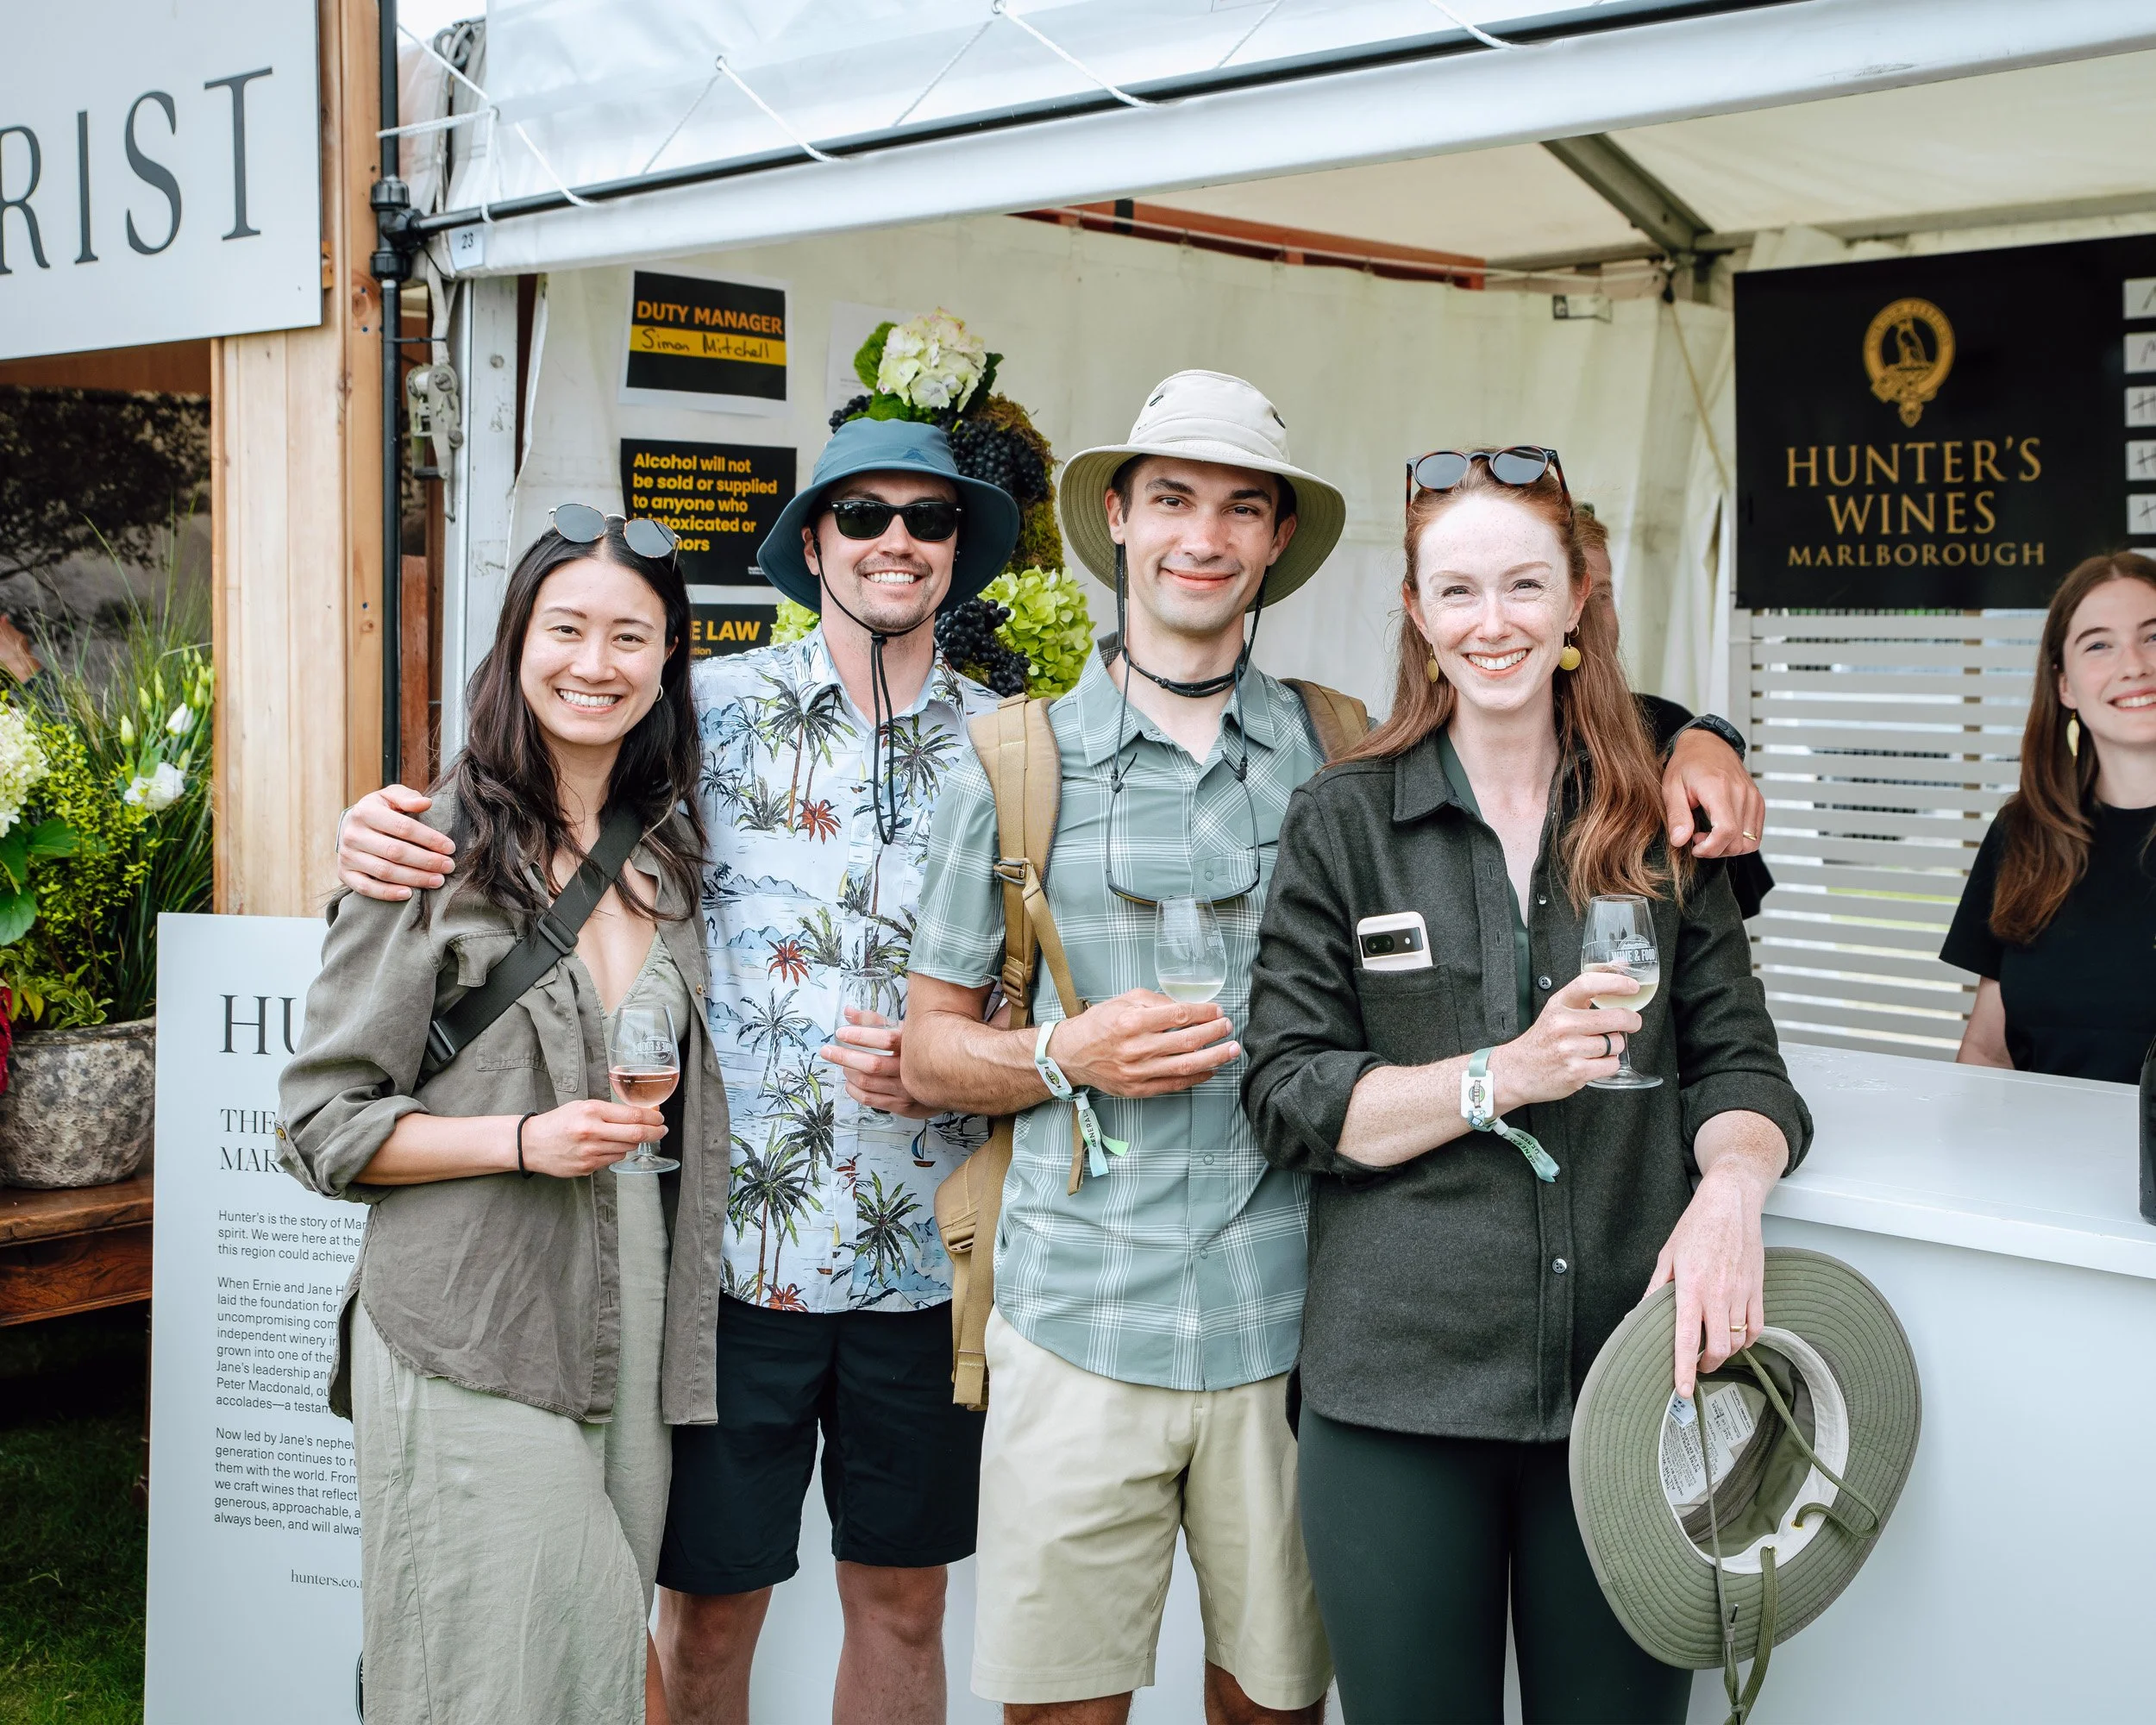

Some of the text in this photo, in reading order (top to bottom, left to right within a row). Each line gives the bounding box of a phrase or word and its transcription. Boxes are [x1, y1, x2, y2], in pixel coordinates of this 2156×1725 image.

[0, 66, 273, 275] RIST
[461, 231, 473, 249] 23
[636, 300, 783, 335] DUTY MANAGER
[642, 327, 769, 359] Simon Mitchell
[634, 453, 751, 473] Alcohol will not
[1787, 436, 2042, 486] HUNTER'S
[633, 474, 777, 497] be sold or supplied
[633, 494, 748, 514] to anyone who
[1826, 491, 1996, 536] WINES
[649, 513, 739, 532] toxicated
[742, 521, 756, 532] or
[1787, 543, 2045, 567] MARLBOROUGH
[706, 621, 761, 641] LAW
[220, 1109, 275, 1134] THE
[268, 1214, 276, 1224] is
[280, 1214, 297, 1226] the
[300, 1216, 327, 1229] story
[330, 1218, 341, 1228] of
[218, 1227, 360, 1246] spirit. We were here at the
[218, 1244, 354, 1263] this region could achieve
[218, 1276, 344, 1295] When Ernie and Jane H
[218, 1295, 338, 1312] laid the foundation for
[218, 1313, 310, 1329] uncompromising
[217, 1327, 286, 1342] independent
[290, 1334, 326, 1347] winery
[217, 1346, 332, 1363] grown into one of the
[253, 1364, 310, 1380] leadership
[217, 1377, 245, 1389] Peter
[249, 1380, 313, 1397] Macdonald,
[216, 1427, 241, 1440] Now
[244, 1430, 260, 1441] led
[265, 1432, 277, 1445] by
[216, 1446, 273, 1459] generation
[278, 1452, 332, 1465] continues
[335, 1456, 346, 1466] to
[216, 1462, 242, 1474] them
[247, 1465, 269, 1476] with
[273, 1467, 290, 1477] the
[294, 1471, 327, 1481] world.
[215, 1481, 357, 1501] we craft wines that reflect
[215, 1497, 360, 1519] generous, approachable, a
[215, 1513, 251, 1527] always
[255, 1515, 285, 1529] been,
[288, 1521, 308, 1530] and
[312, 1521, 329, 1533] will
